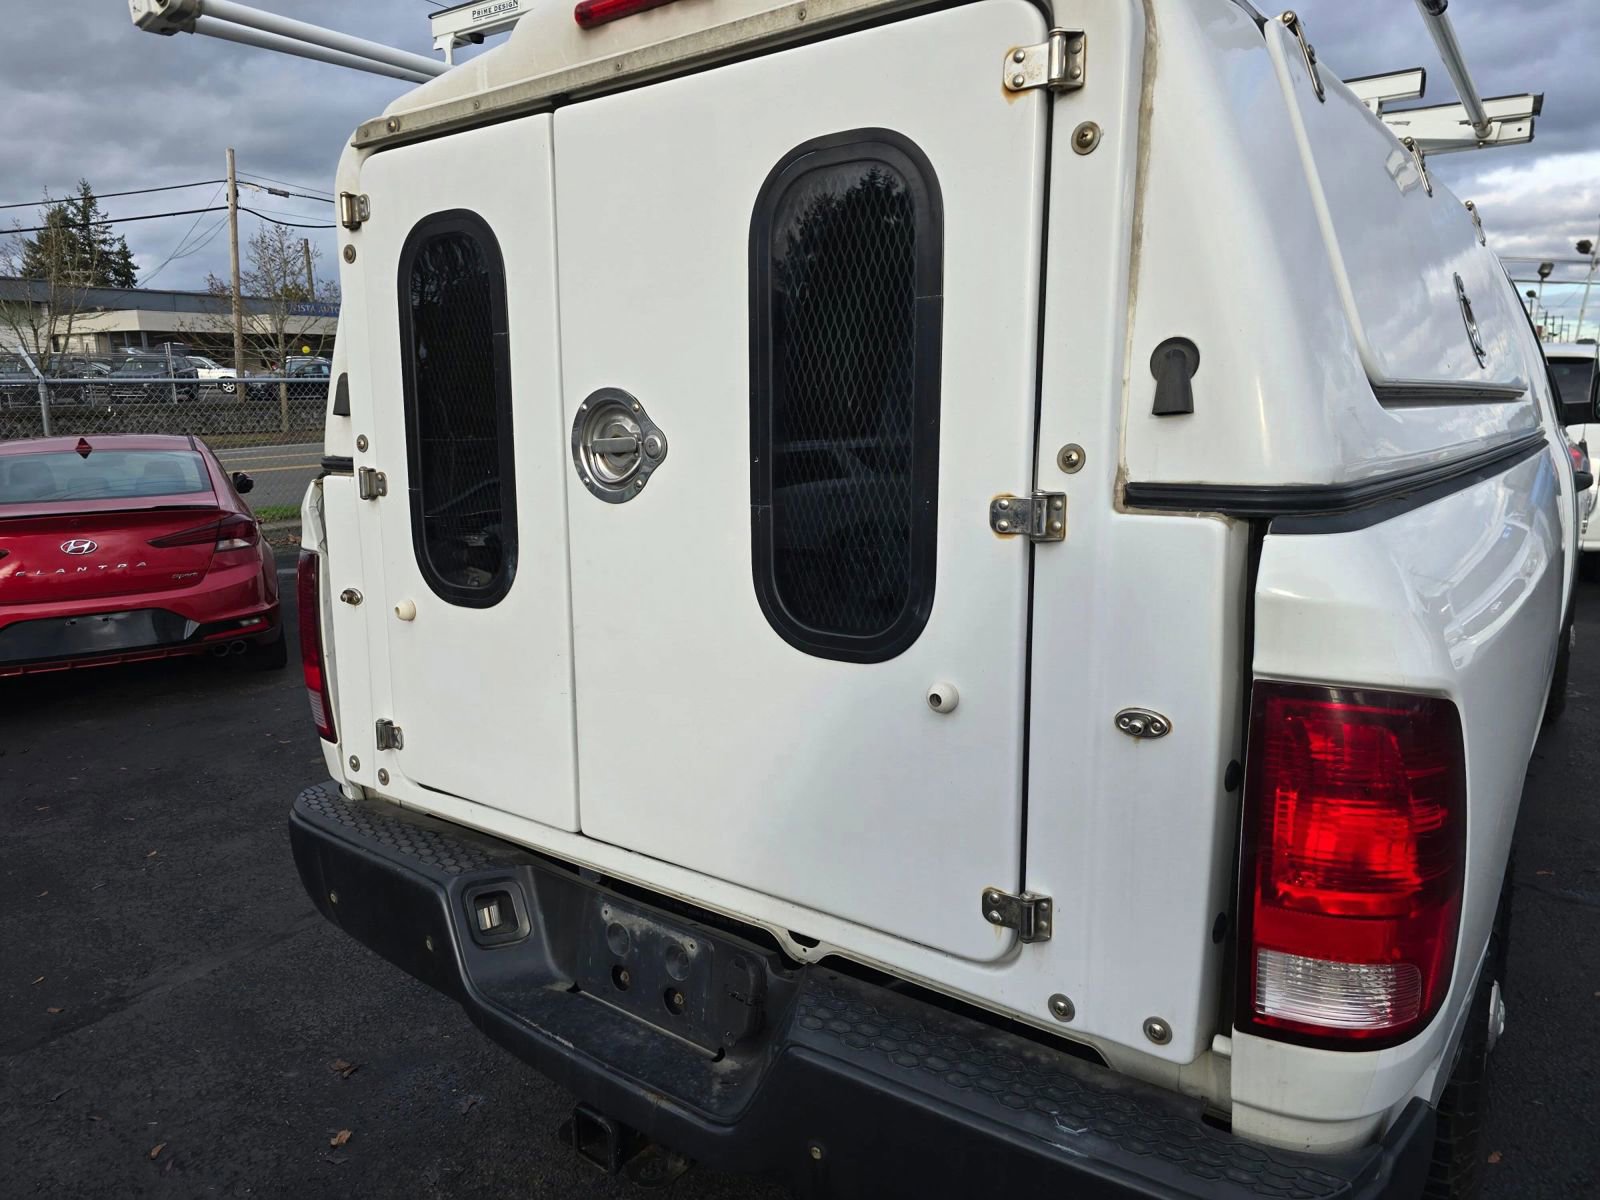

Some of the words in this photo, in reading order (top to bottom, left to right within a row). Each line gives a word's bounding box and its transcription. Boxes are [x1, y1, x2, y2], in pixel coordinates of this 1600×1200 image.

[472, 7, 491, 17] PRIME
[494, 0, 518, 11] DESIGN
[15, 561, 147, 577] ELANTRA
